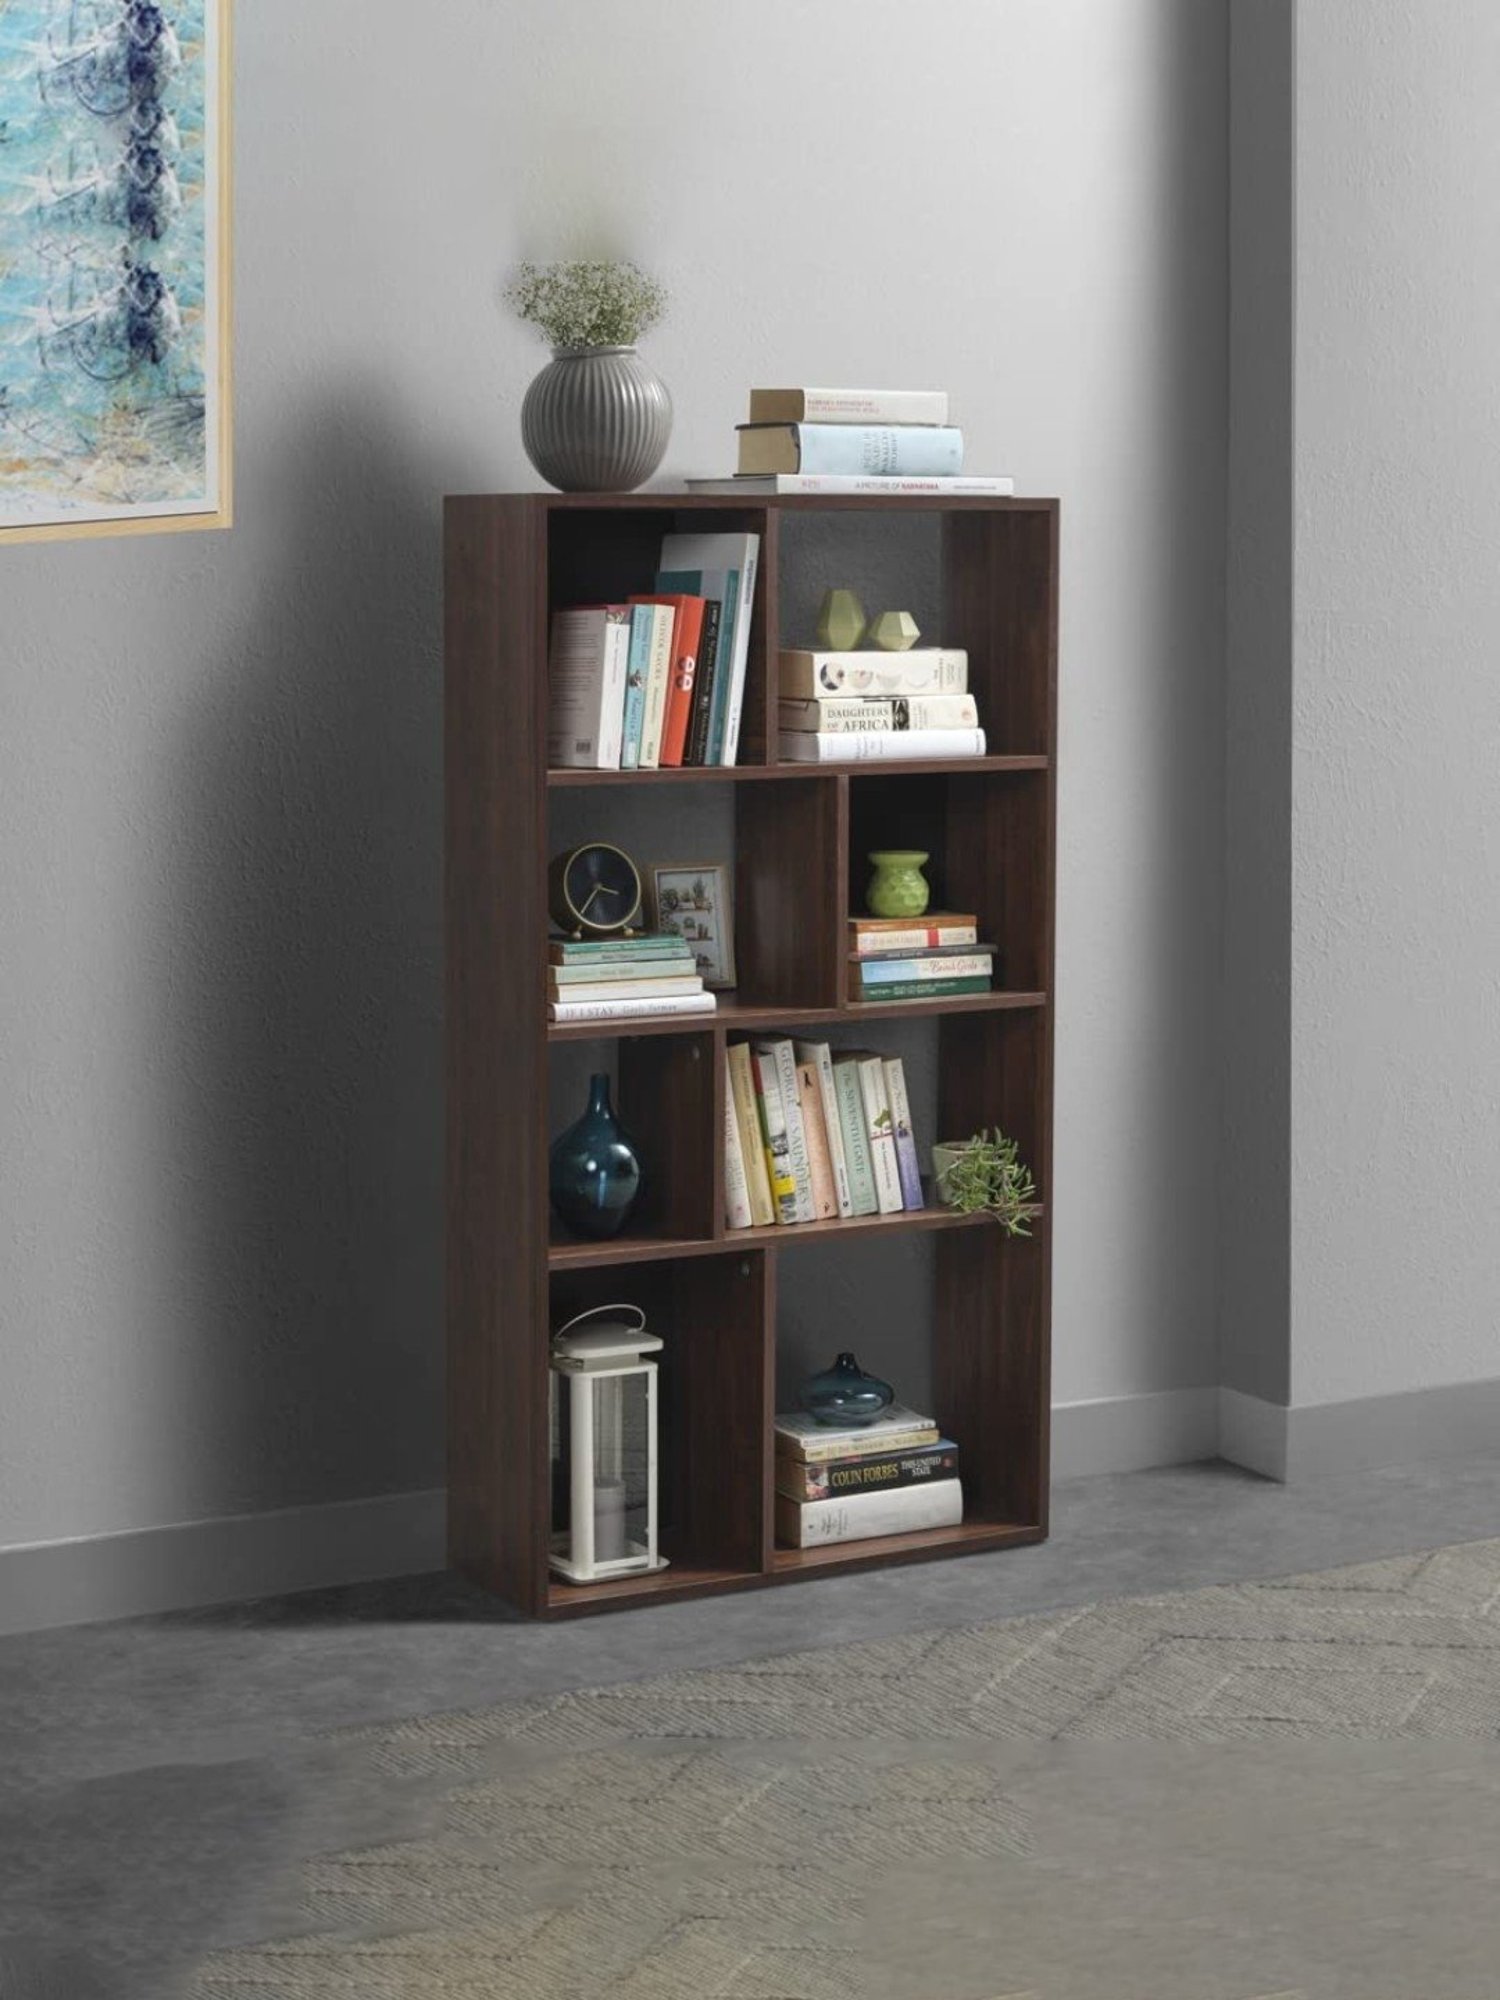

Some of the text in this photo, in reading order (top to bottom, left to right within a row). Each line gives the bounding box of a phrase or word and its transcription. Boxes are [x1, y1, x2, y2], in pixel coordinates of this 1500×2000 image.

[862, 482, 889, 490] PICTURE
[891, 482, 900, 490] OF
[827, 707, 889, 719] DAUGHTERS
[843, 719, 889, 732] AFRICA
[588, 1006, 614, 1018] STAY
[781, 1046, 797, 1108] GEORGE
[845, 1089, 860, 1141] SEVENTH
[853, 1144, 865, 1174] GATE
[791, 1124, 809, 1204] SAUNDERS
[832, 1462, 899, 1487] COLIN FORBES
